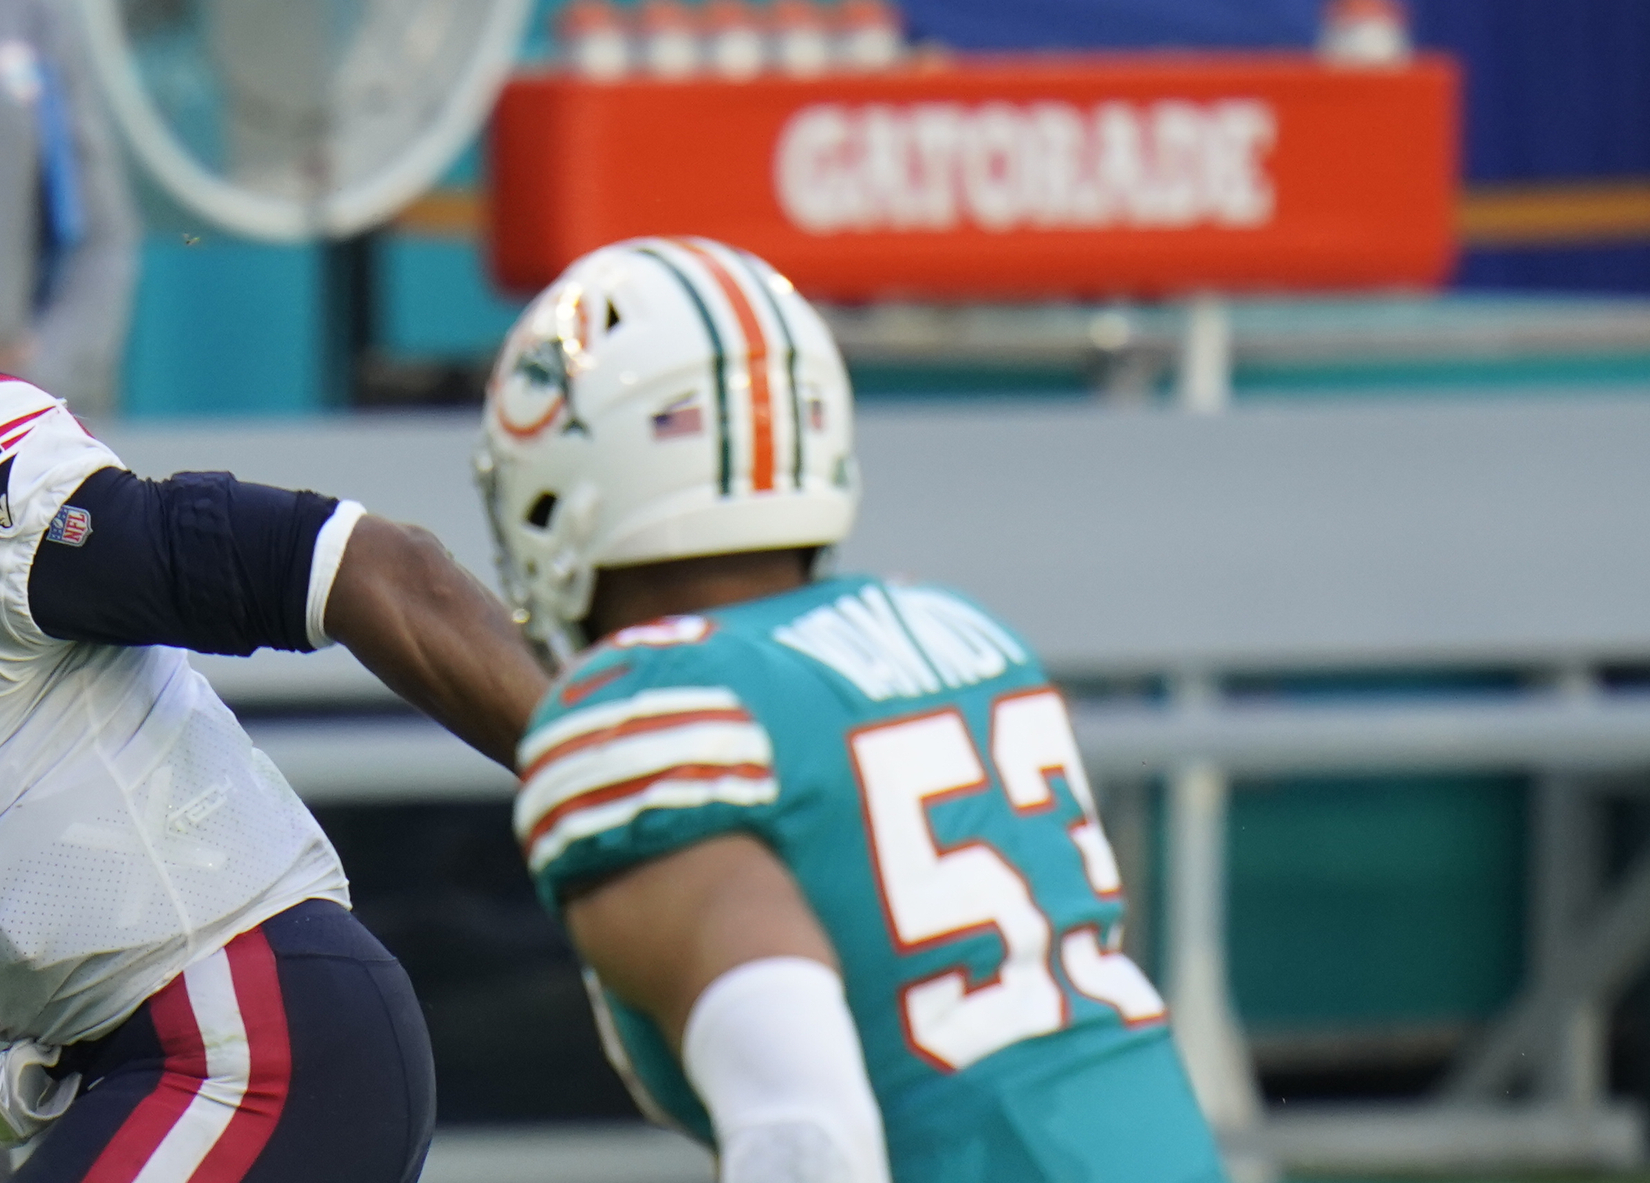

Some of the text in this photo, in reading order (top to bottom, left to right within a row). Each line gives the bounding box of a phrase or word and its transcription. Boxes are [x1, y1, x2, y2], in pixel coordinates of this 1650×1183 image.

[774, 102, 1276, 234] GATORADE
[62, 513, 87, 542] NFL
[846, 685, 1169, 1076] 53
